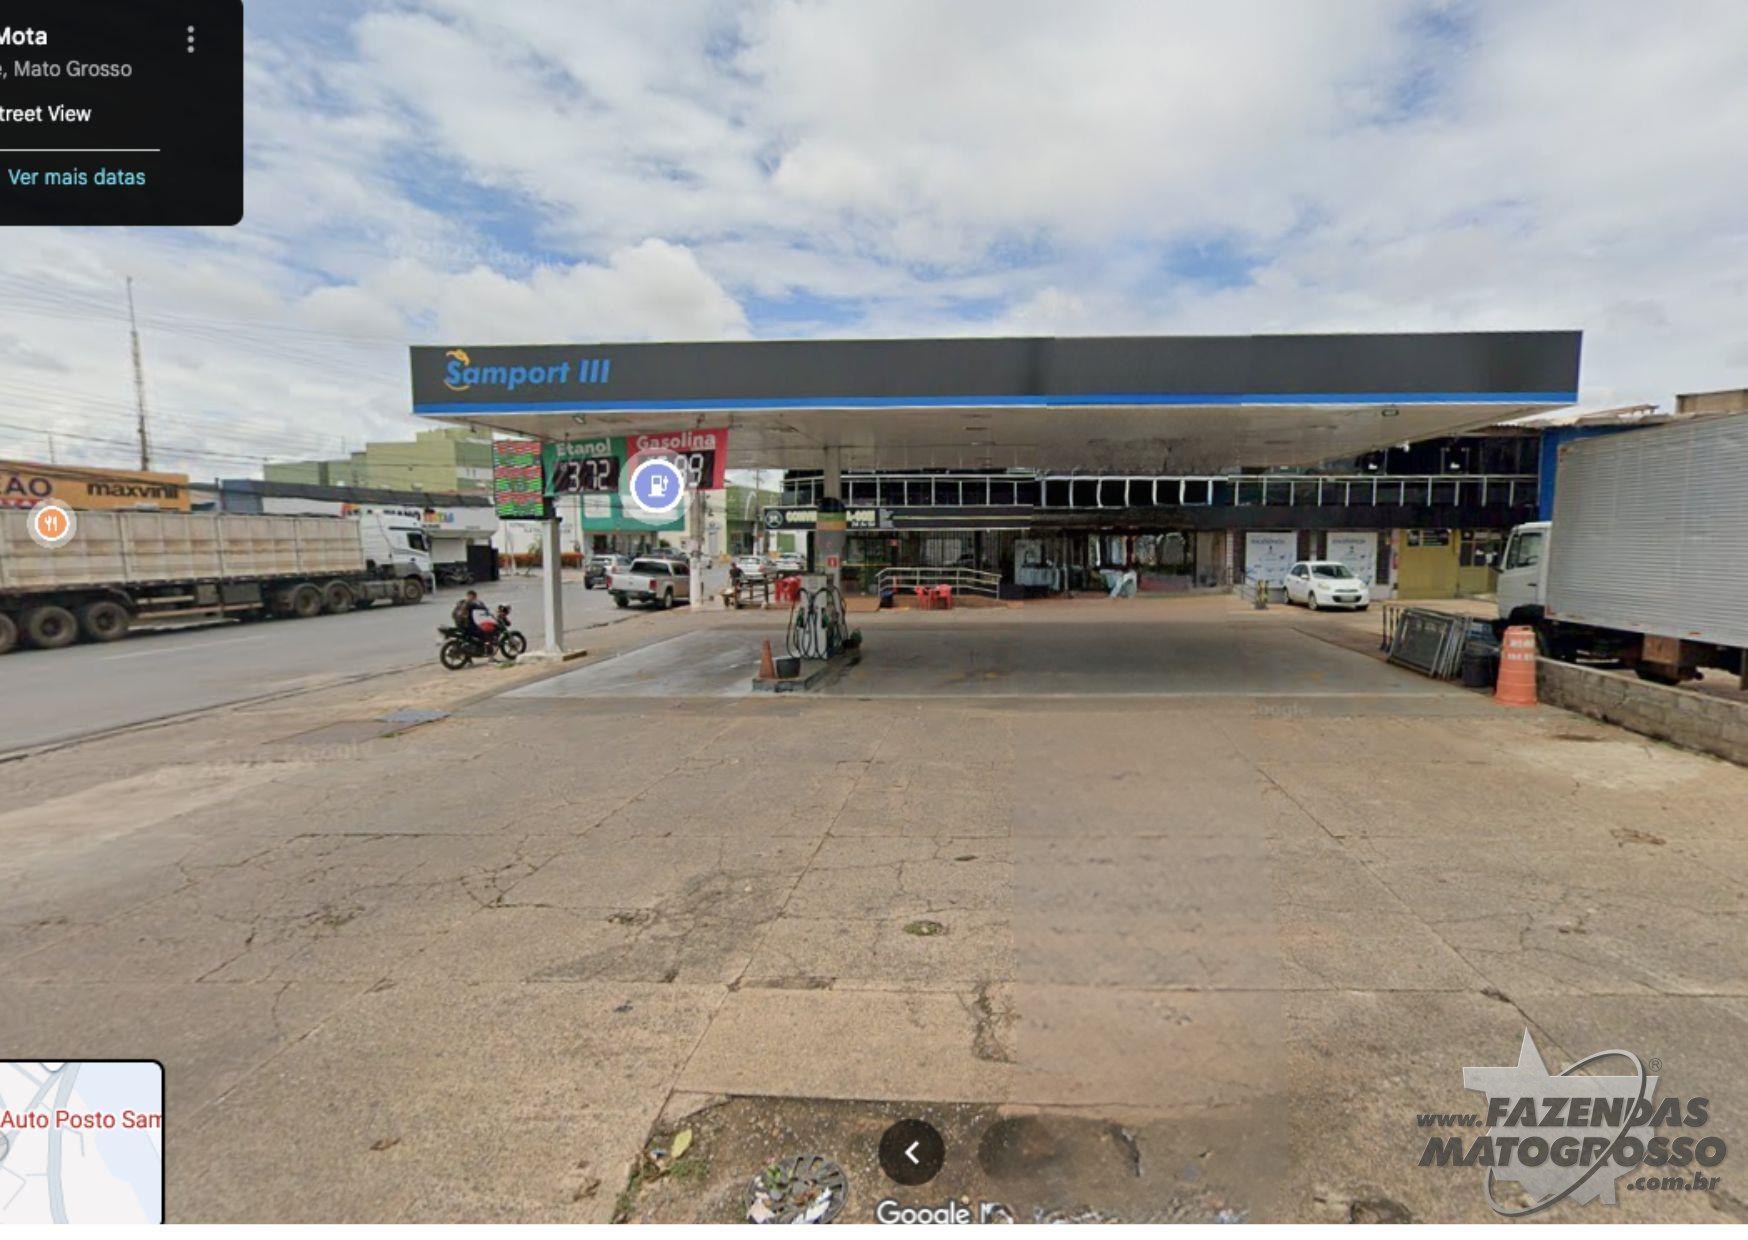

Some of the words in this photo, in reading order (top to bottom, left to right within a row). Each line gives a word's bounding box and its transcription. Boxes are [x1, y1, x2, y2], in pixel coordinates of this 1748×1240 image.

[446, 360, 571, 391] Samport
[578, 359, 611, 384] III
[555, 437, 612, 457] Etanol
[636, 431, 716, 450] Gasolina
[0, 470, 53, 498] ÃO
